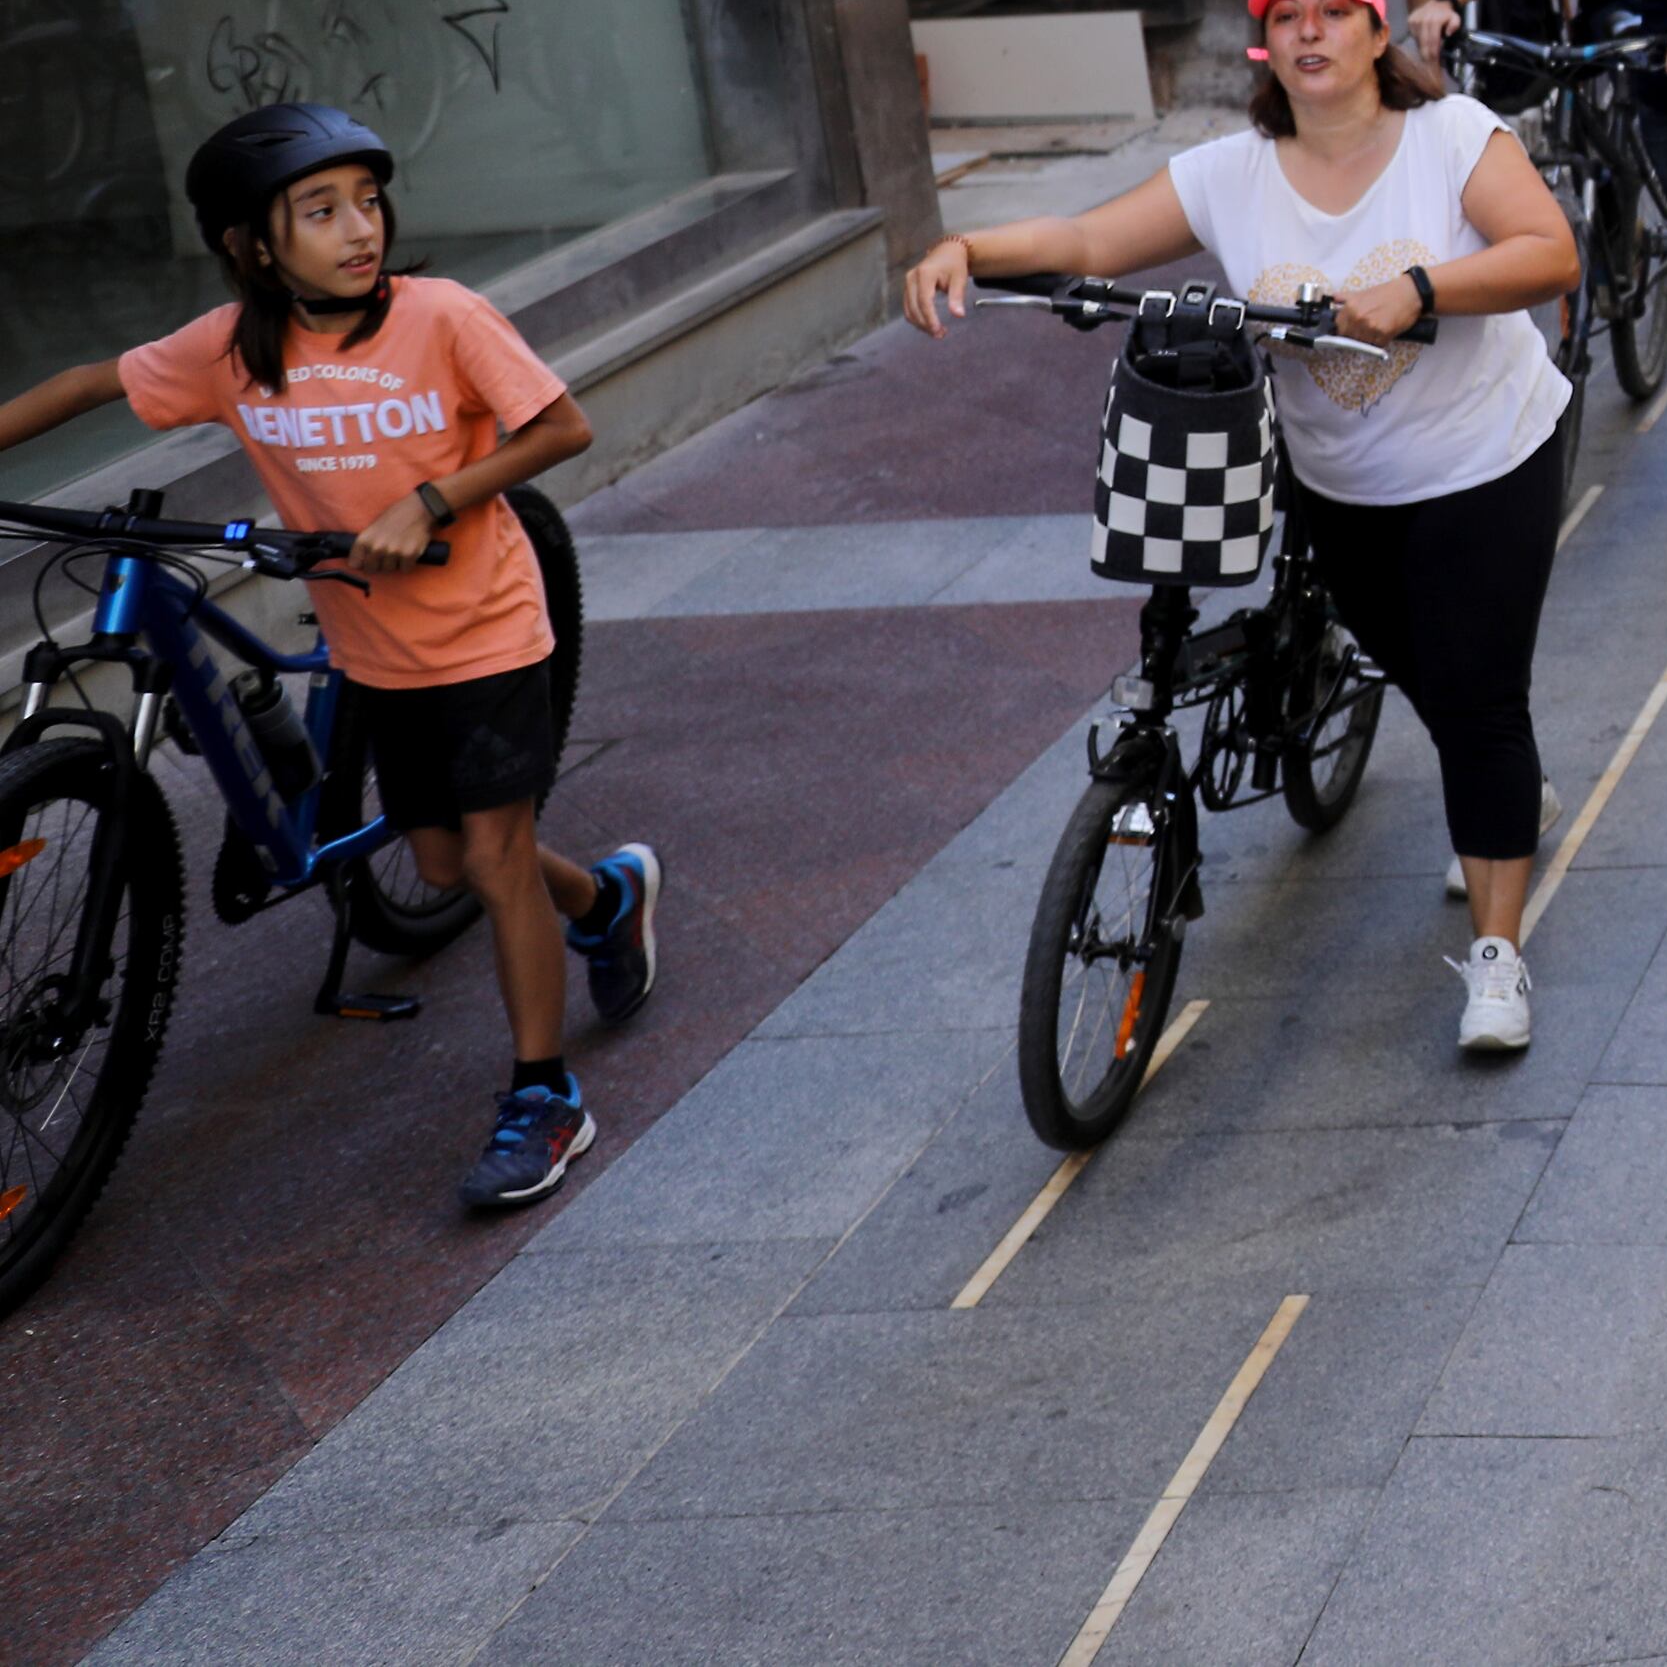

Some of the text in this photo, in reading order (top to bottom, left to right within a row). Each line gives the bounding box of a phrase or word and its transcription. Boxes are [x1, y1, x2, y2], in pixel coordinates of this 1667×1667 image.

[314, 363, 379, 383] COLORS
[380, 372, 405, 392] OF
[237, 389, 446, 449] BENETTON
[296, 454, 378, 473] SINCE 1979
[157, 913, 176, 983] COMP
